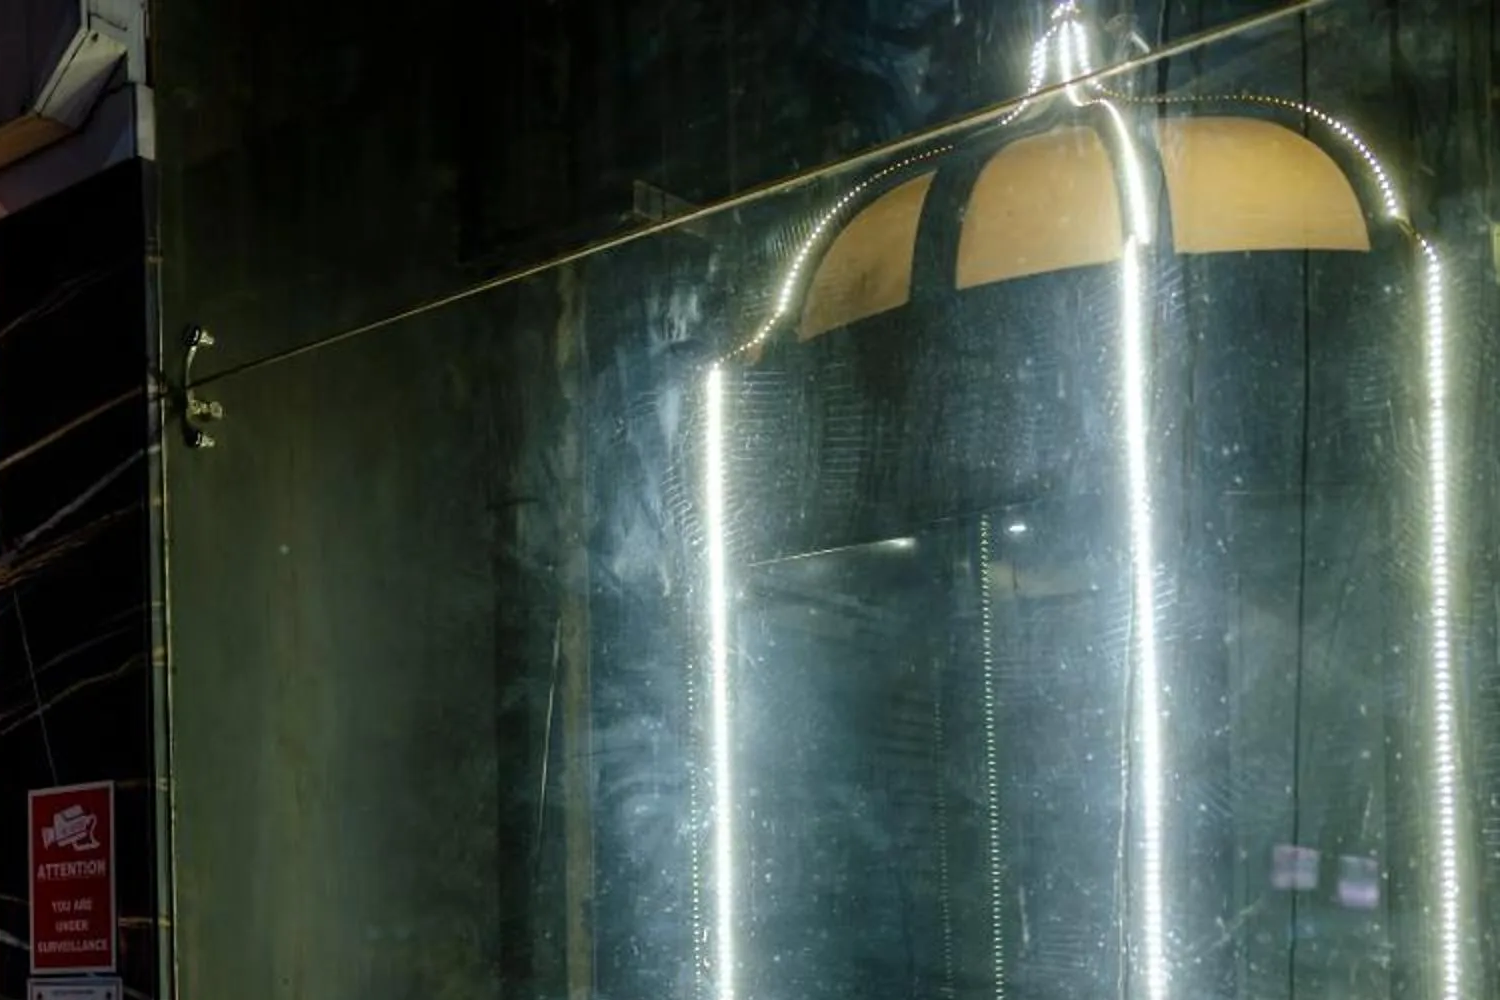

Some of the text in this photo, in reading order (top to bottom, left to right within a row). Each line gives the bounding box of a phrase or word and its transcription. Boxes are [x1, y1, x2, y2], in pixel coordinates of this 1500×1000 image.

[37, 859, 106, 881] ATTENTION
[51, 898, 93, 914] YOU ARE
[55, 919, 90, 933] UNDER
[37, 938, 109, 954] SURVEILLANCE
